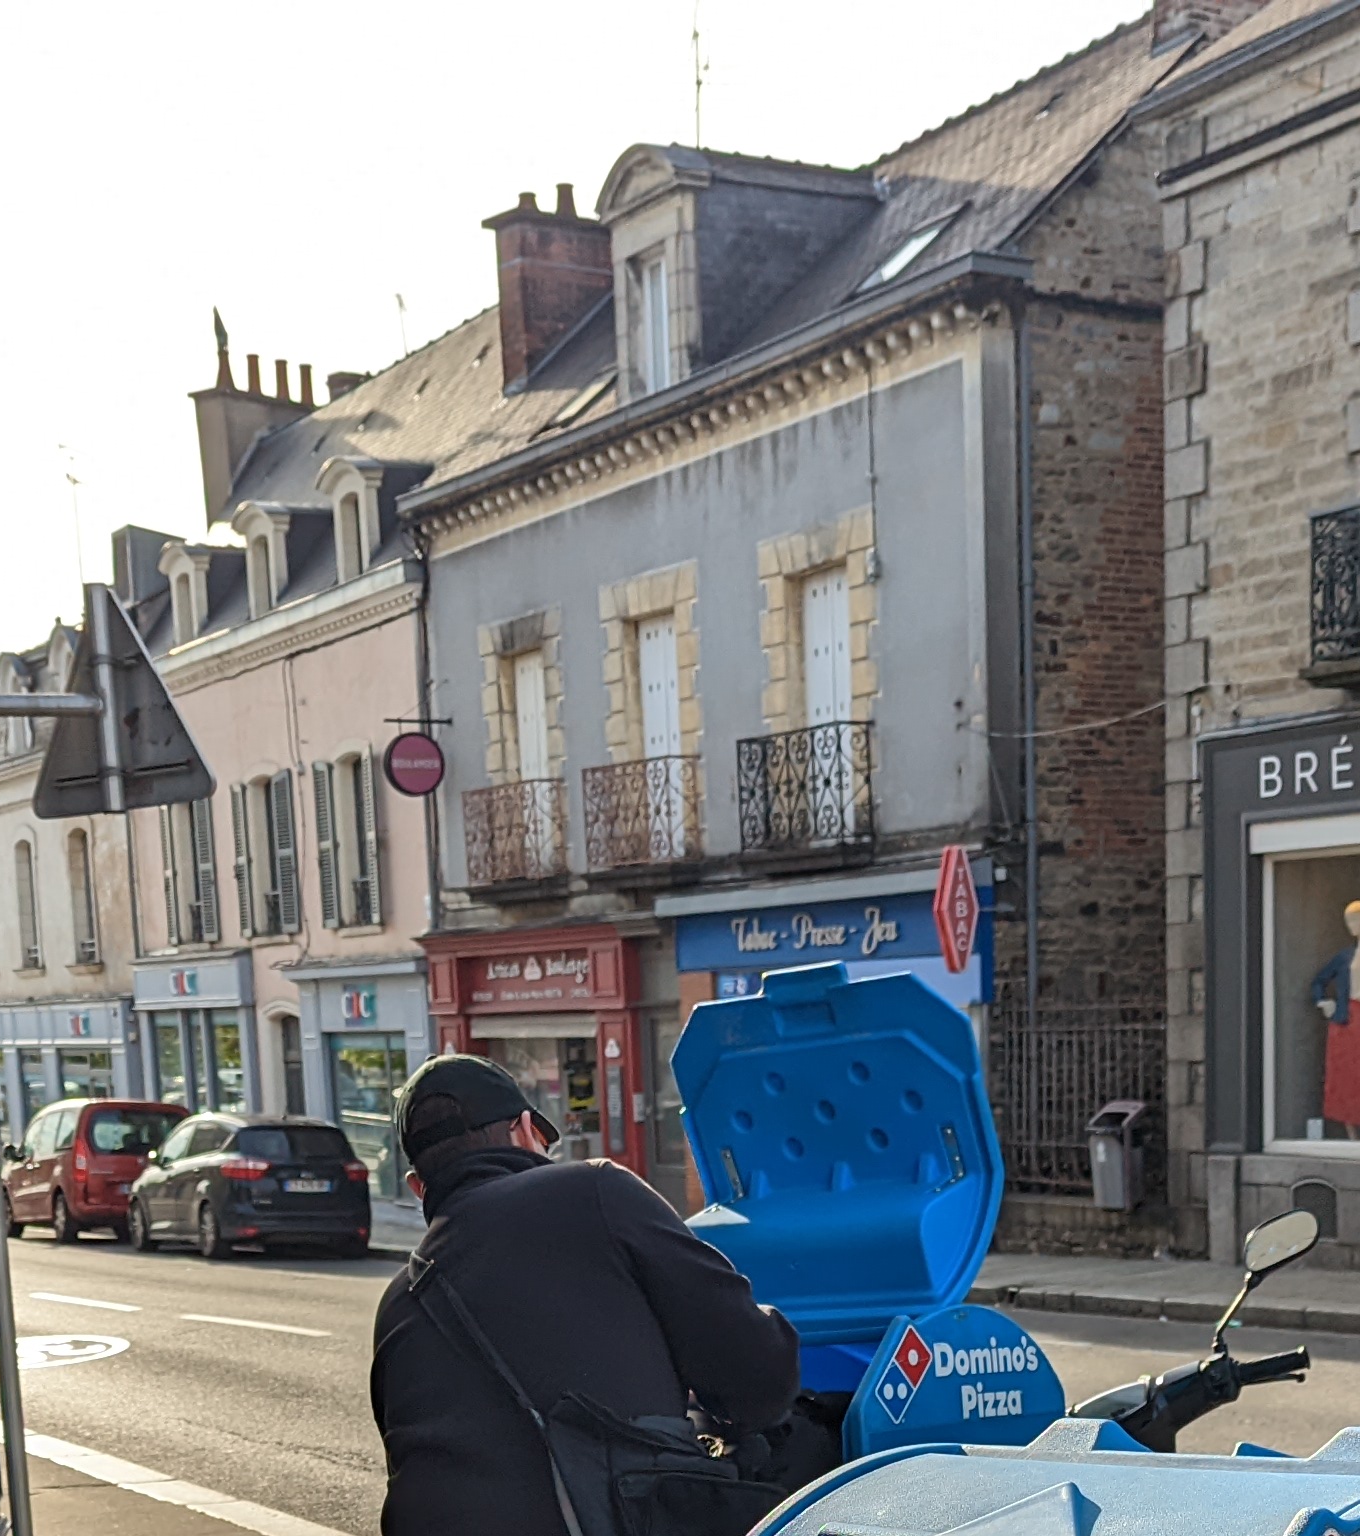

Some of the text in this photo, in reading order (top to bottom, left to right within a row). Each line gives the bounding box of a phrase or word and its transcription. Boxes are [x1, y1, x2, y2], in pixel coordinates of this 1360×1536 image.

[955, 867, 968, 952] TABAC
[791, 912, 846, 950] Presse
[341, 991, 372, 1020] CIC
[933, 1336, 1039, 1377] Domino's
[961, 1381, 1024, 1420] Pizza
